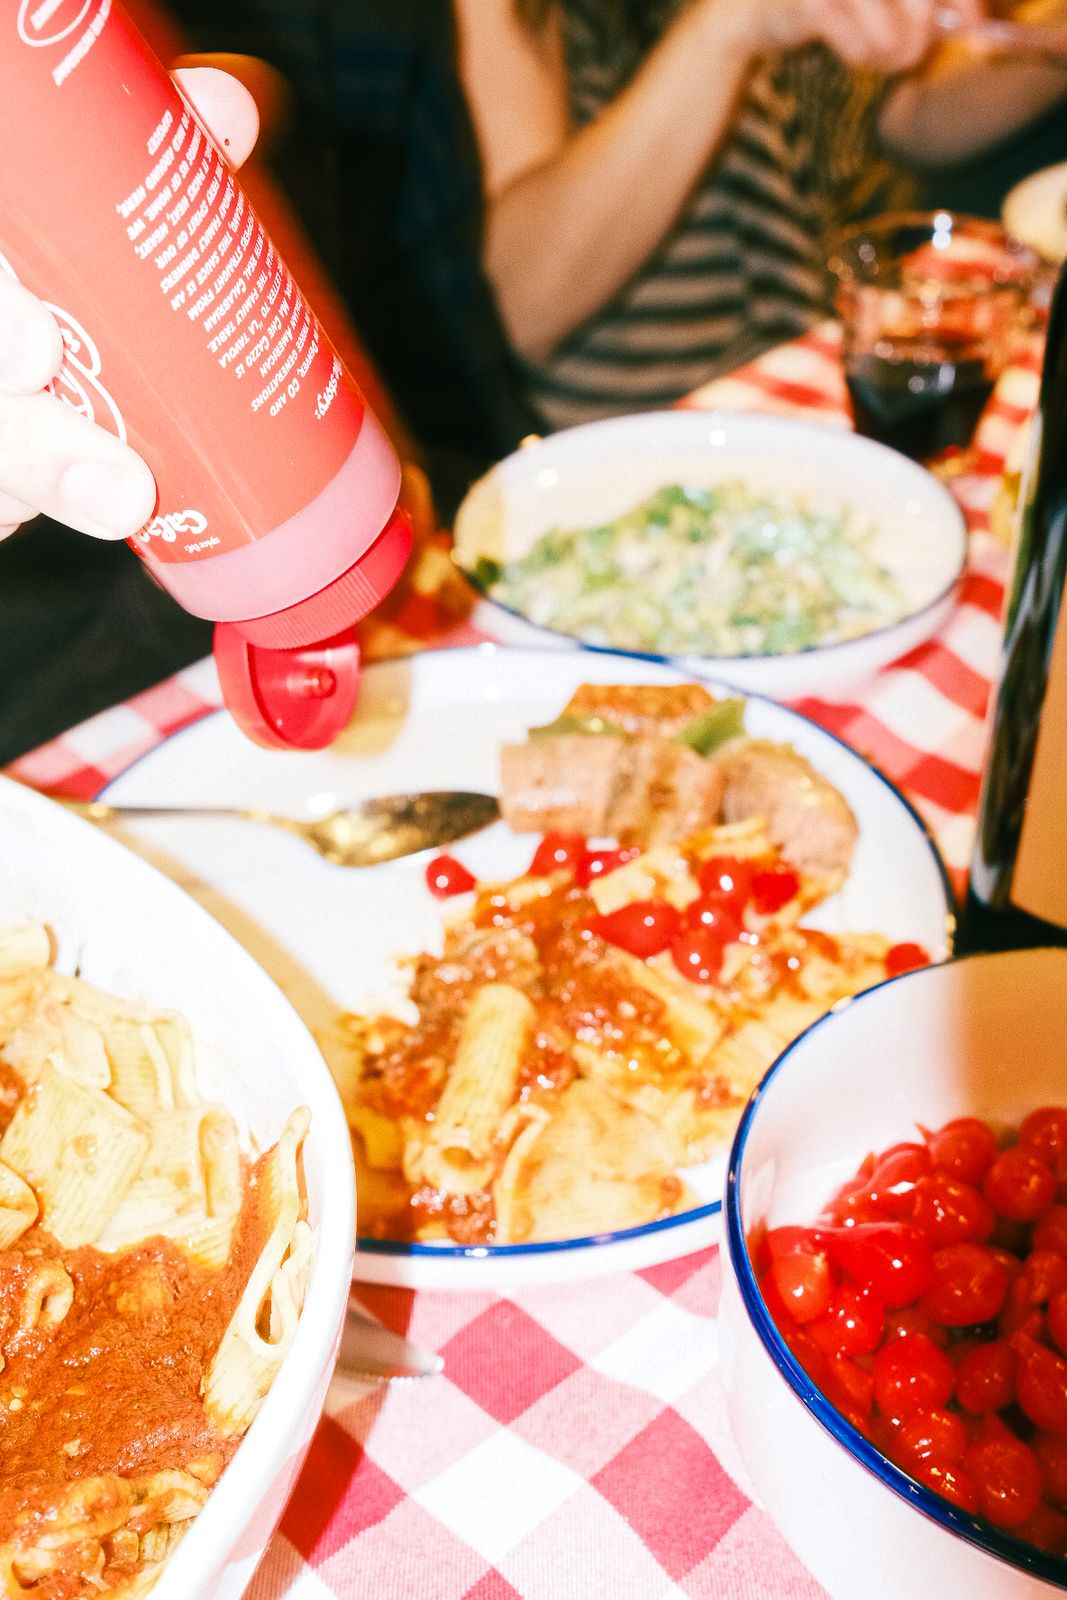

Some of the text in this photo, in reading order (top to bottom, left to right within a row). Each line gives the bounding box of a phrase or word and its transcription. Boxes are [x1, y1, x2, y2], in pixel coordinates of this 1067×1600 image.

[171, 172, 182, 192] OF
[206, 176, 220, 206] FIERY
[218, 182, 235, 220] SUNDAY
[126, 218, 146, 241] WE
[187, 199, 209, 236] SPIRIT
[176, 230, 189, 250] OF
[198, 214, 222, 253] FAMILY
[217, 231, 233, 257] THIS
[154, 244, 177, 269] OUR
[160, 247, 200, 294] DINNERS
[196, 250, 220, 285] SAUCE
[214, 246, 243, 294] STRAIGHT
[242, 254, 258, 281] REAL
[170, 290, 186, 311] AN
[185, 280, 197, 297] IS
[266, 272, 282, 305] LETTER
[187, 288, 215, 321] FROM
[204, 278, 247, 332] CALABRIAN
[207, 270, 268, 353] THE FAMILY TABLE.
[260, 301, 271, 318] TO
[278, 297, 290, 318] MA
[267, 315, 282, 339] CHE
[295, 322, 309, 352] THREE
[218, 332, 250, 368] TAVOLA
[245, 335, 270, 367] CAZZO
[259, 326, 293, 377] AMERICAN
[296, 340, 319, 378] DENVER,
[235, 363, 246, 379] IS
[251, 349, 298, 412] GENERATIONS
[287, 378, 300, 399] CO
[314, 373, 338, 419] story:
[269, 393, 287, 417] AND
